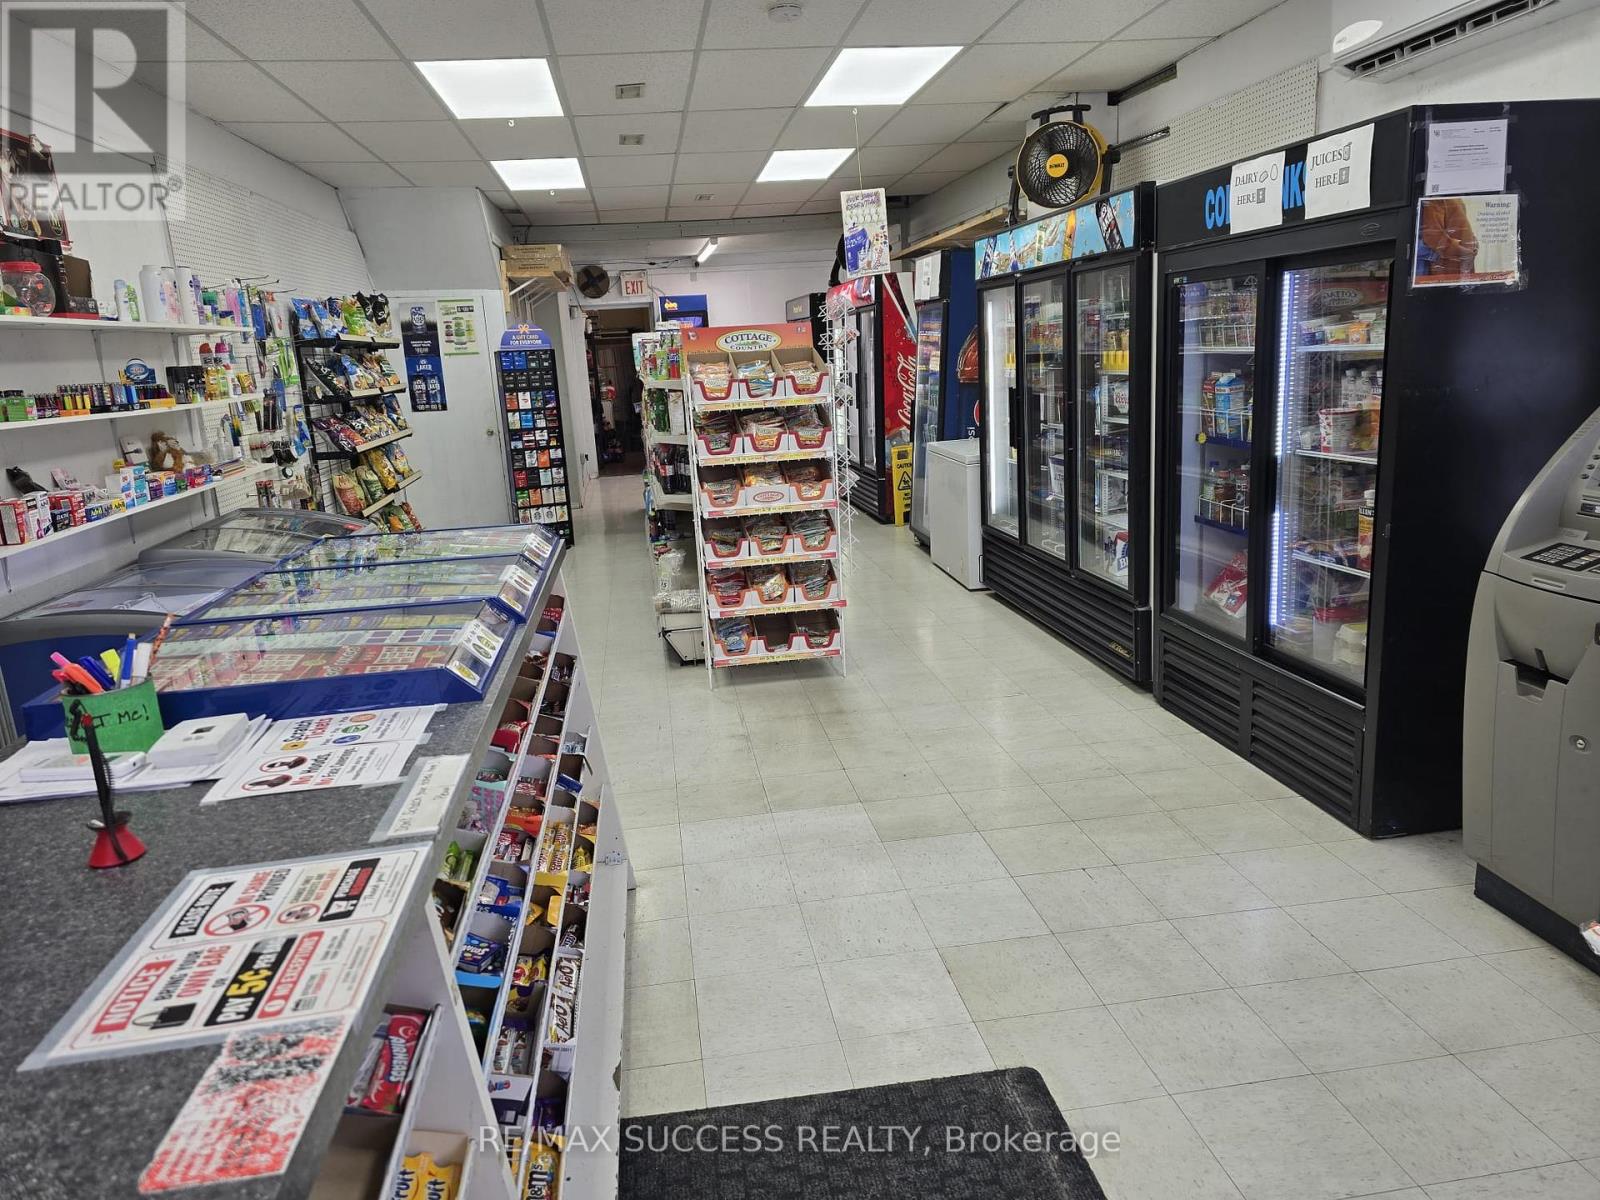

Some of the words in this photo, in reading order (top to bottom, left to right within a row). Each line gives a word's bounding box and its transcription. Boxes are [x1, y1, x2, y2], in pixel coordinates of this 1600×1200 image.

[1311, 150, 1343, 171] JUICES
[1235, 171, 1259, 187] DAIRY
[1315, 173, 1338, 188] HERE
[1237, 195, 1257, 205] HERE
[625, 280, 644, 295] EXIT
[724, 333, 773, 344] COTTAGE
[730, 342, 768, 351] COUNTRY
[284, 719, 312, 743] Scratch
[305, 717, 333, 741] Tickets
[243, 869, 273, 893] CHANGE
[256, 868, 291, 902] PROVIDED
[170, 903, 215, 935] PLEASE
[199, 885, 229, 904] NOTE
[284, 937, 320, 980] EXCEPTIONS
[153, 975, 187, 1001] BRING
[180, 950, 203, 975] YOUR
[176, 969, 215, 998] OWN
[200, 945, 231, 969] BAG
[229, 969, 274, 996] 5¢
[98, 965, 165, 1027] NOTICE
[216, 997, 256, 1023] PAY
[388, 1036, 408, 1082] AIRHEADS
